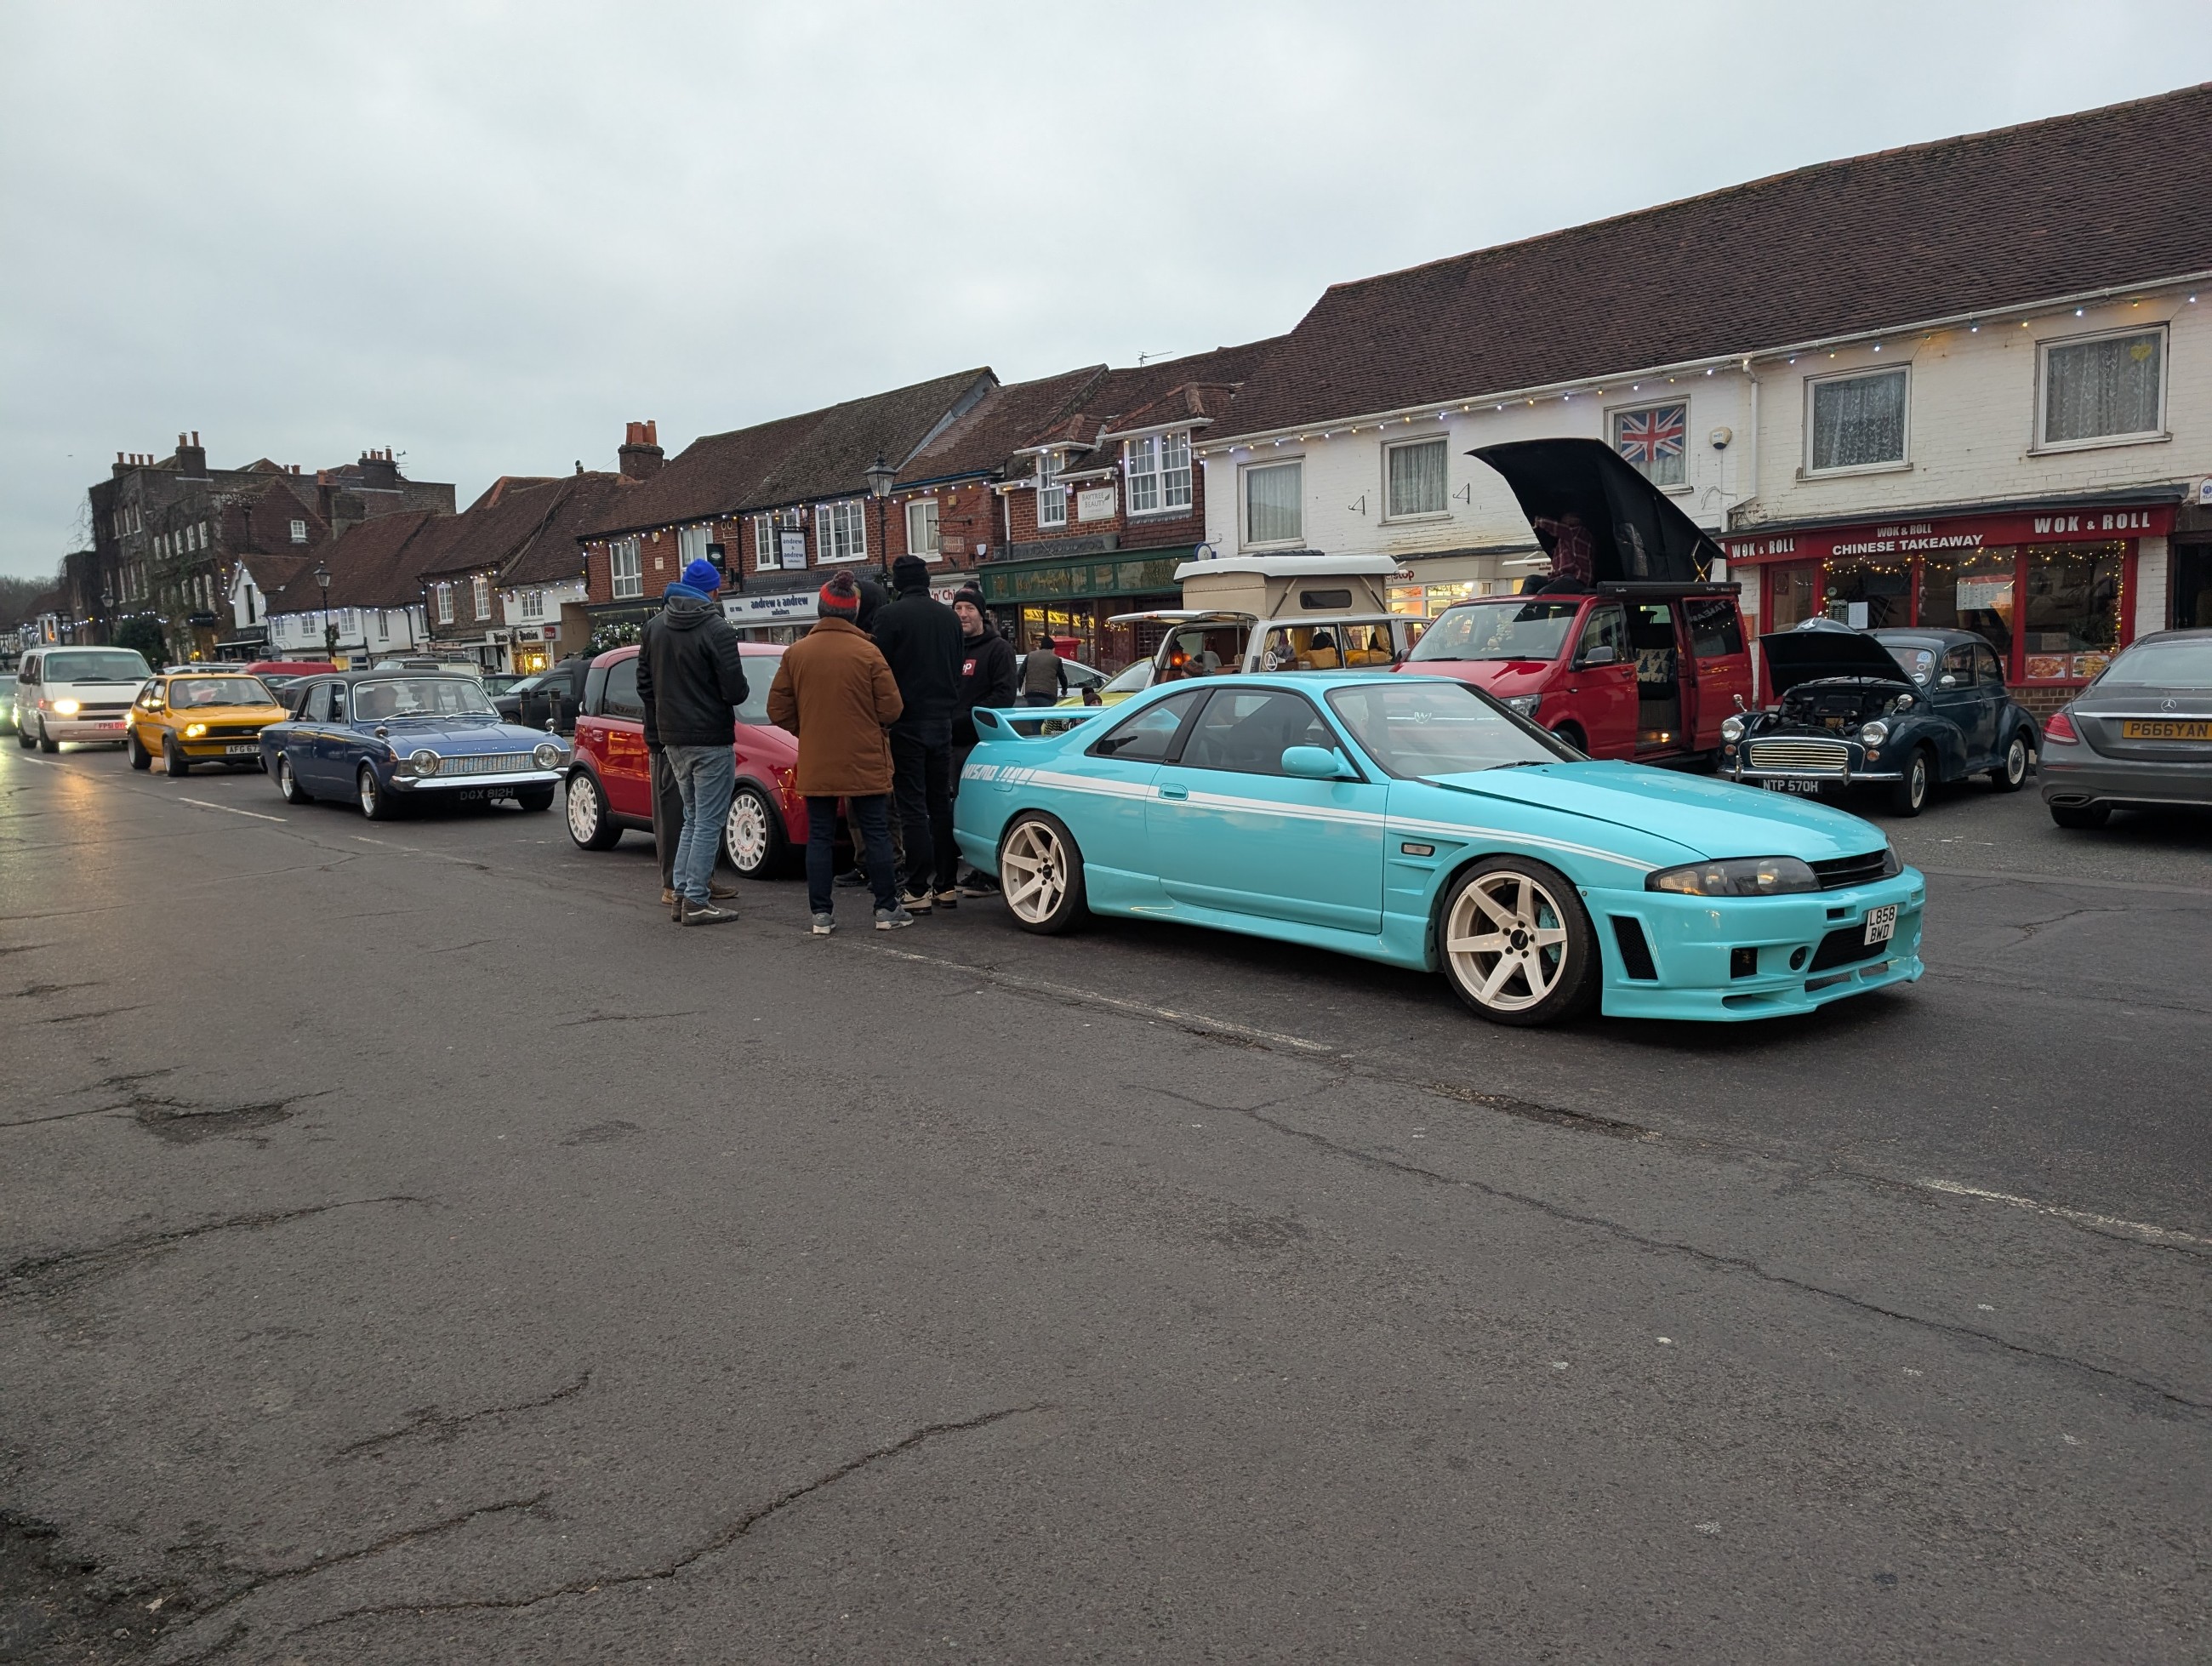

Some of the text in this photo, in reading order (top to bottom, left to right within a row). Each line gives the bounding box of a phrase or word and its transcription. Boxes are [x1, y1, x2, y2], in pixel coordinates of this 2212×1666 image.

[1877, 527, 1899, 538] WOK
[1910, 524, 1932, 534] ROLL
[2034, 512, 2150, 533] WOK & ROLL
[1731, 538, 1794, 558] WOK & ROLL
[1833, 534, 1983, 556] CHINESE TAKEAWAY
[750, 595, 808, 609] andrew & andrew
[943, 589, 955, 601] Chi
[1763, 779, 1819, 792] NTP 570H
[460, 790, 484, 801] DGX
[1869, 906, 1896, 927] L858
[1869, 923, 1890, 943] BWD
